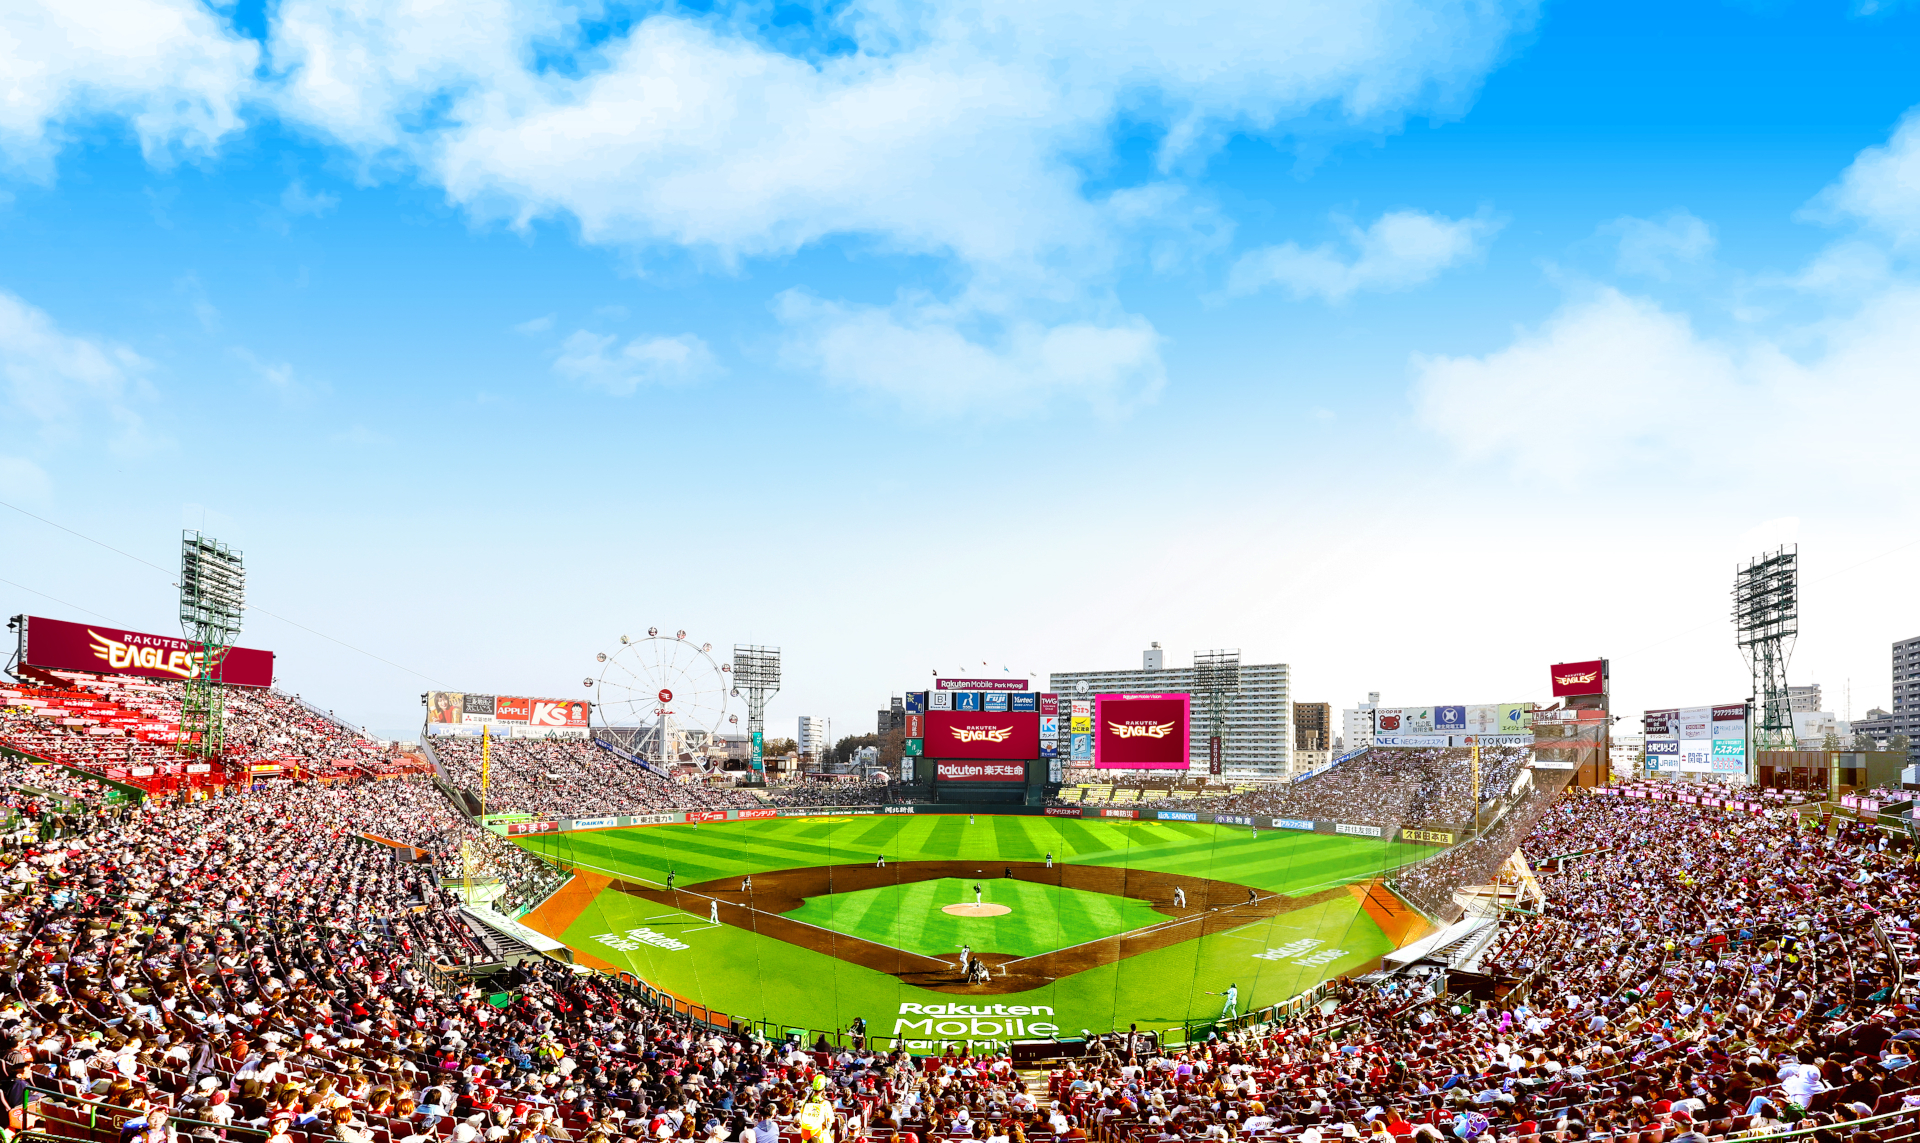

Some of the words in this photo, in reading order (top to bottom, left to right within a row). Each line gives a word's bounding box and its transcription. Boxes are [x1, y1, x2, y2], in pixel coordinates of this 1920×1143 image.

[124, 634, 188, 650] RAKUTEN
[108, 643, 200, 678] EAGLES
[941, 680, 970, 688] Rakuten
[1562, 676, 1591, 686] EAGLES
[986, 694, 1006, 702] Fuji
[498, 707, 528, 715] APPLE
[531, 702, 568, 726] K's
[961, 730, 1004, 742] EAGLES
[1120, 726, 1165, 738] EAGLES
[1714, 745, 1744, 754] トスネット
[1688, 753, 1710, 763] 関電工
[938, 764, 982, 776] Rakuten
[984, 765, 1023, 776] 楽天生命
[1713, 760, 1734, 770] 2525
[641, 816, 667, 824] 東北電力
[517, 822, 549, 833] やまや
[1337, 825, 1380, 836] 三井住友銀行
[1406, 830, 1449, 843] 久保田本店
[624, 927, 690, 951] Rakuten
[899, 1003, 1054, 1016] Rakuten
[893, 1018, 1060, 1036] Mobile
